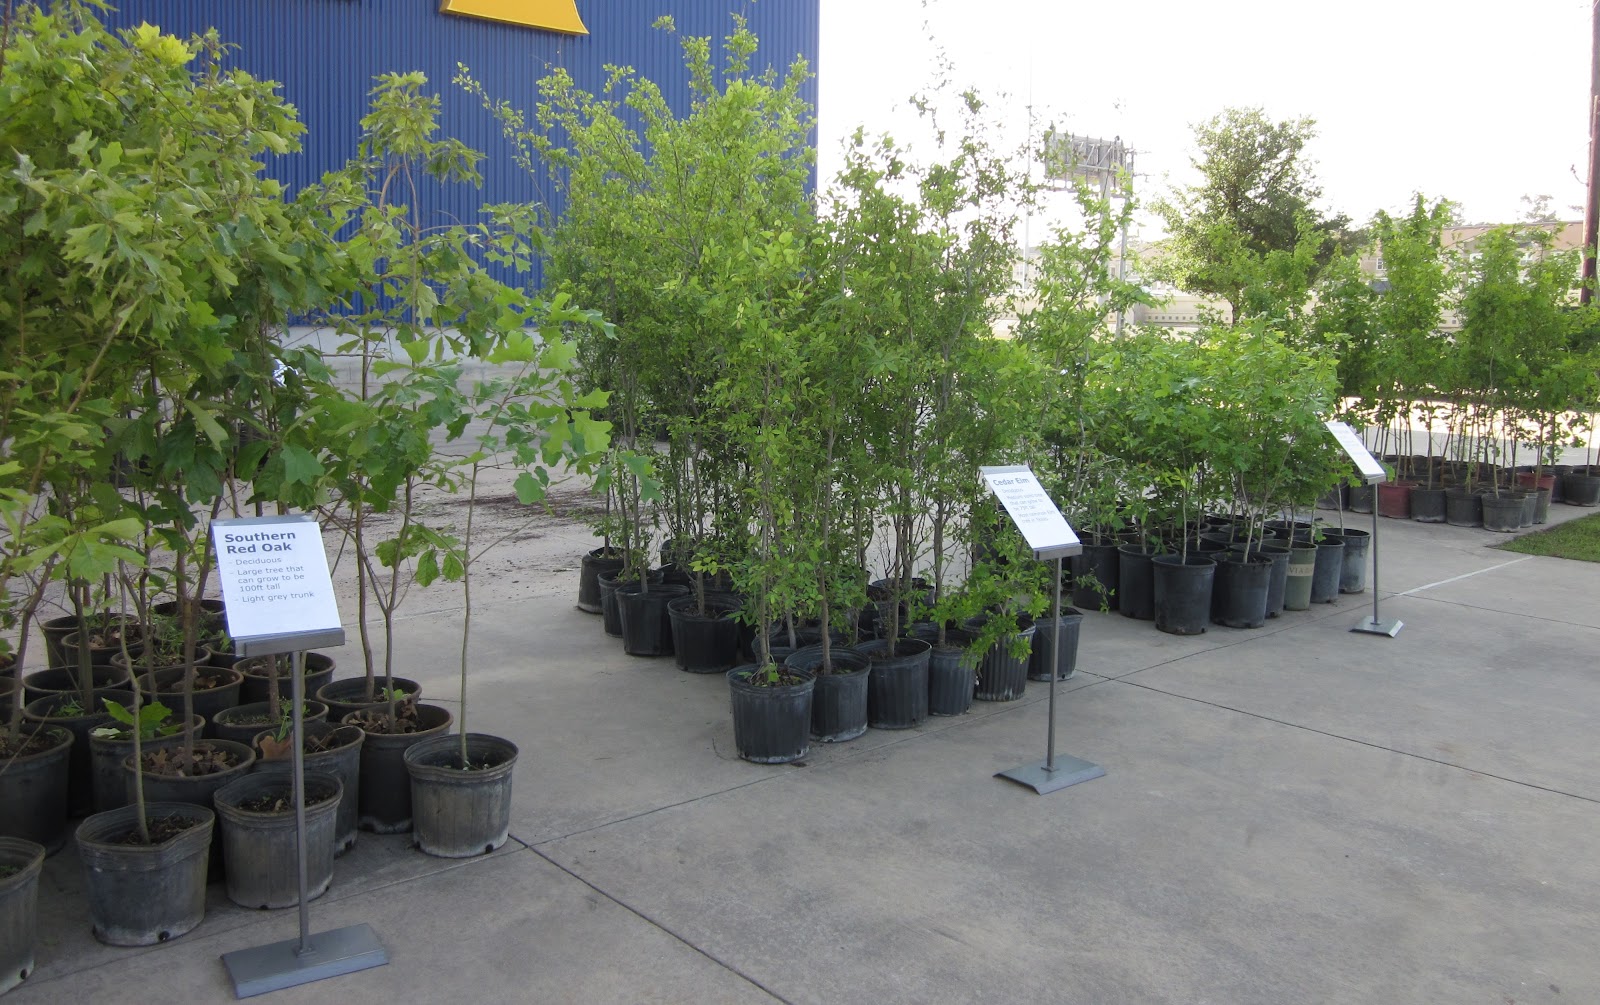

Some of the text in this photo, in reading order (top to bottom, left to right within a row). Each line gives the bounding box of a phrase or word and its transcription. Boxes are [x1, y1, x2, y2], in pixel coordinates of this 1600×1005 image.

[993, 478, 1014, 486] Cedar
[224, 532, 296, 543] Southern
[226, 542, 293, 554] Red Oak
[235, 557, 282, 566] Deciduous
[237, 568, 263, 577] Large
[257, 576, 279, 584] grow
[240, 584, 263, 592] 100ft
[242, 591, 315, 604] Light grey trunk
